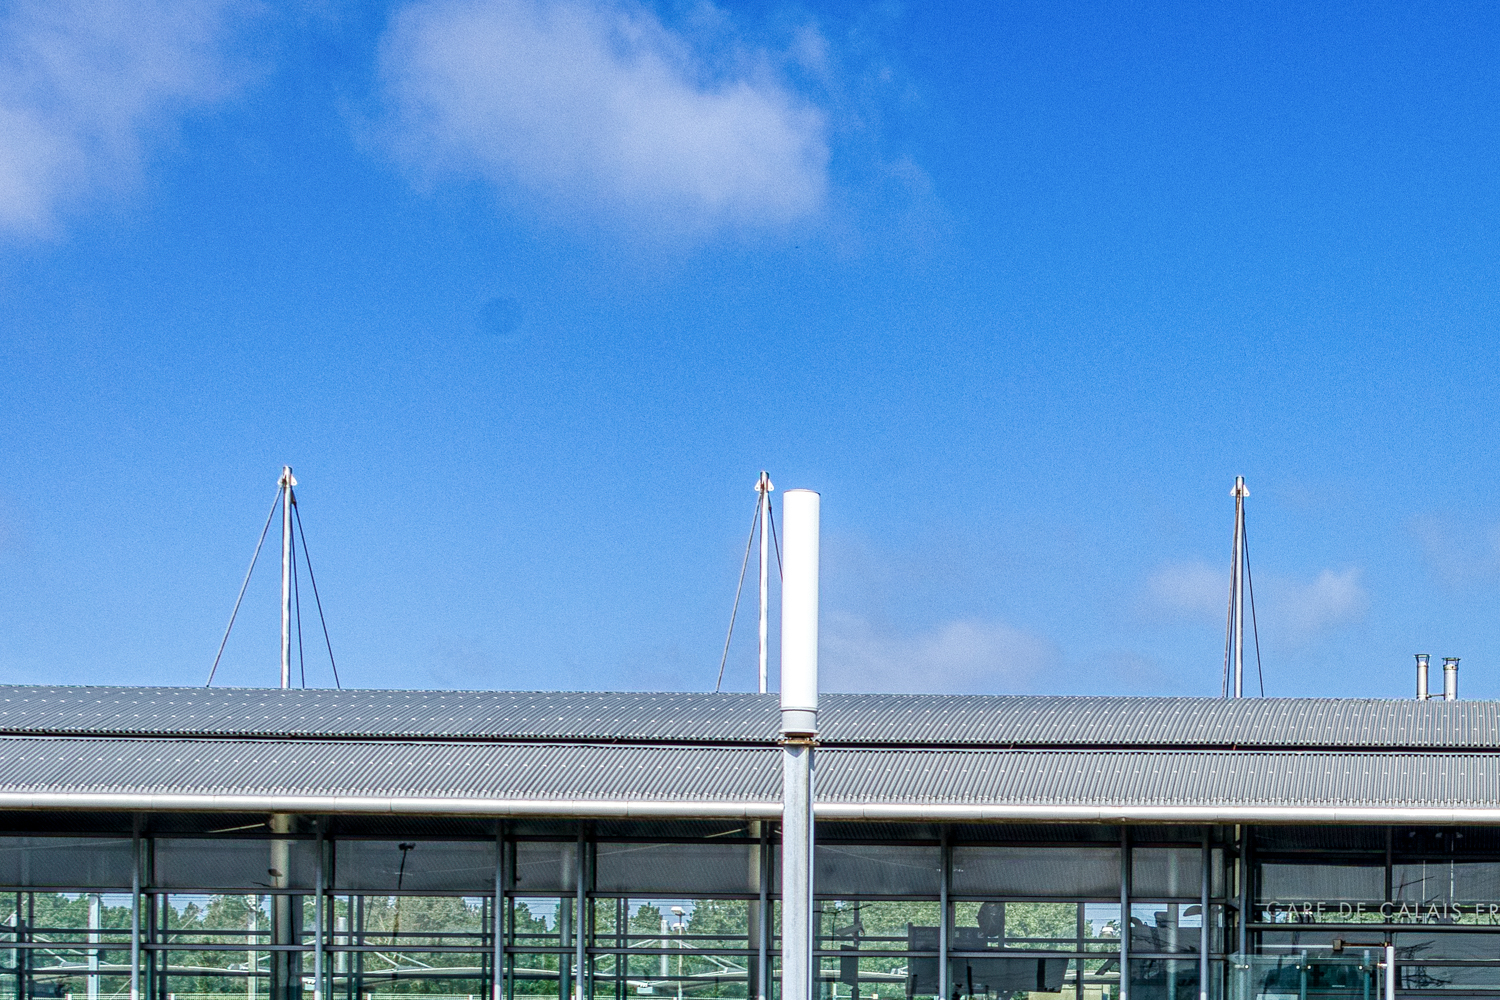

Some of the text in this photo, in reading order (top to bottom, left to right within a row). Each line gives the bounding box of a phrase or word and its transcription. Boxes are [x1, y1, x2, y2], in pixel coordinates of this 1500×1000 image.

[1266, 901, 1326, 918] GARE
[1339, 902, 1367, 918] DE
[1380, 902, 1462, 919] CALAIS
